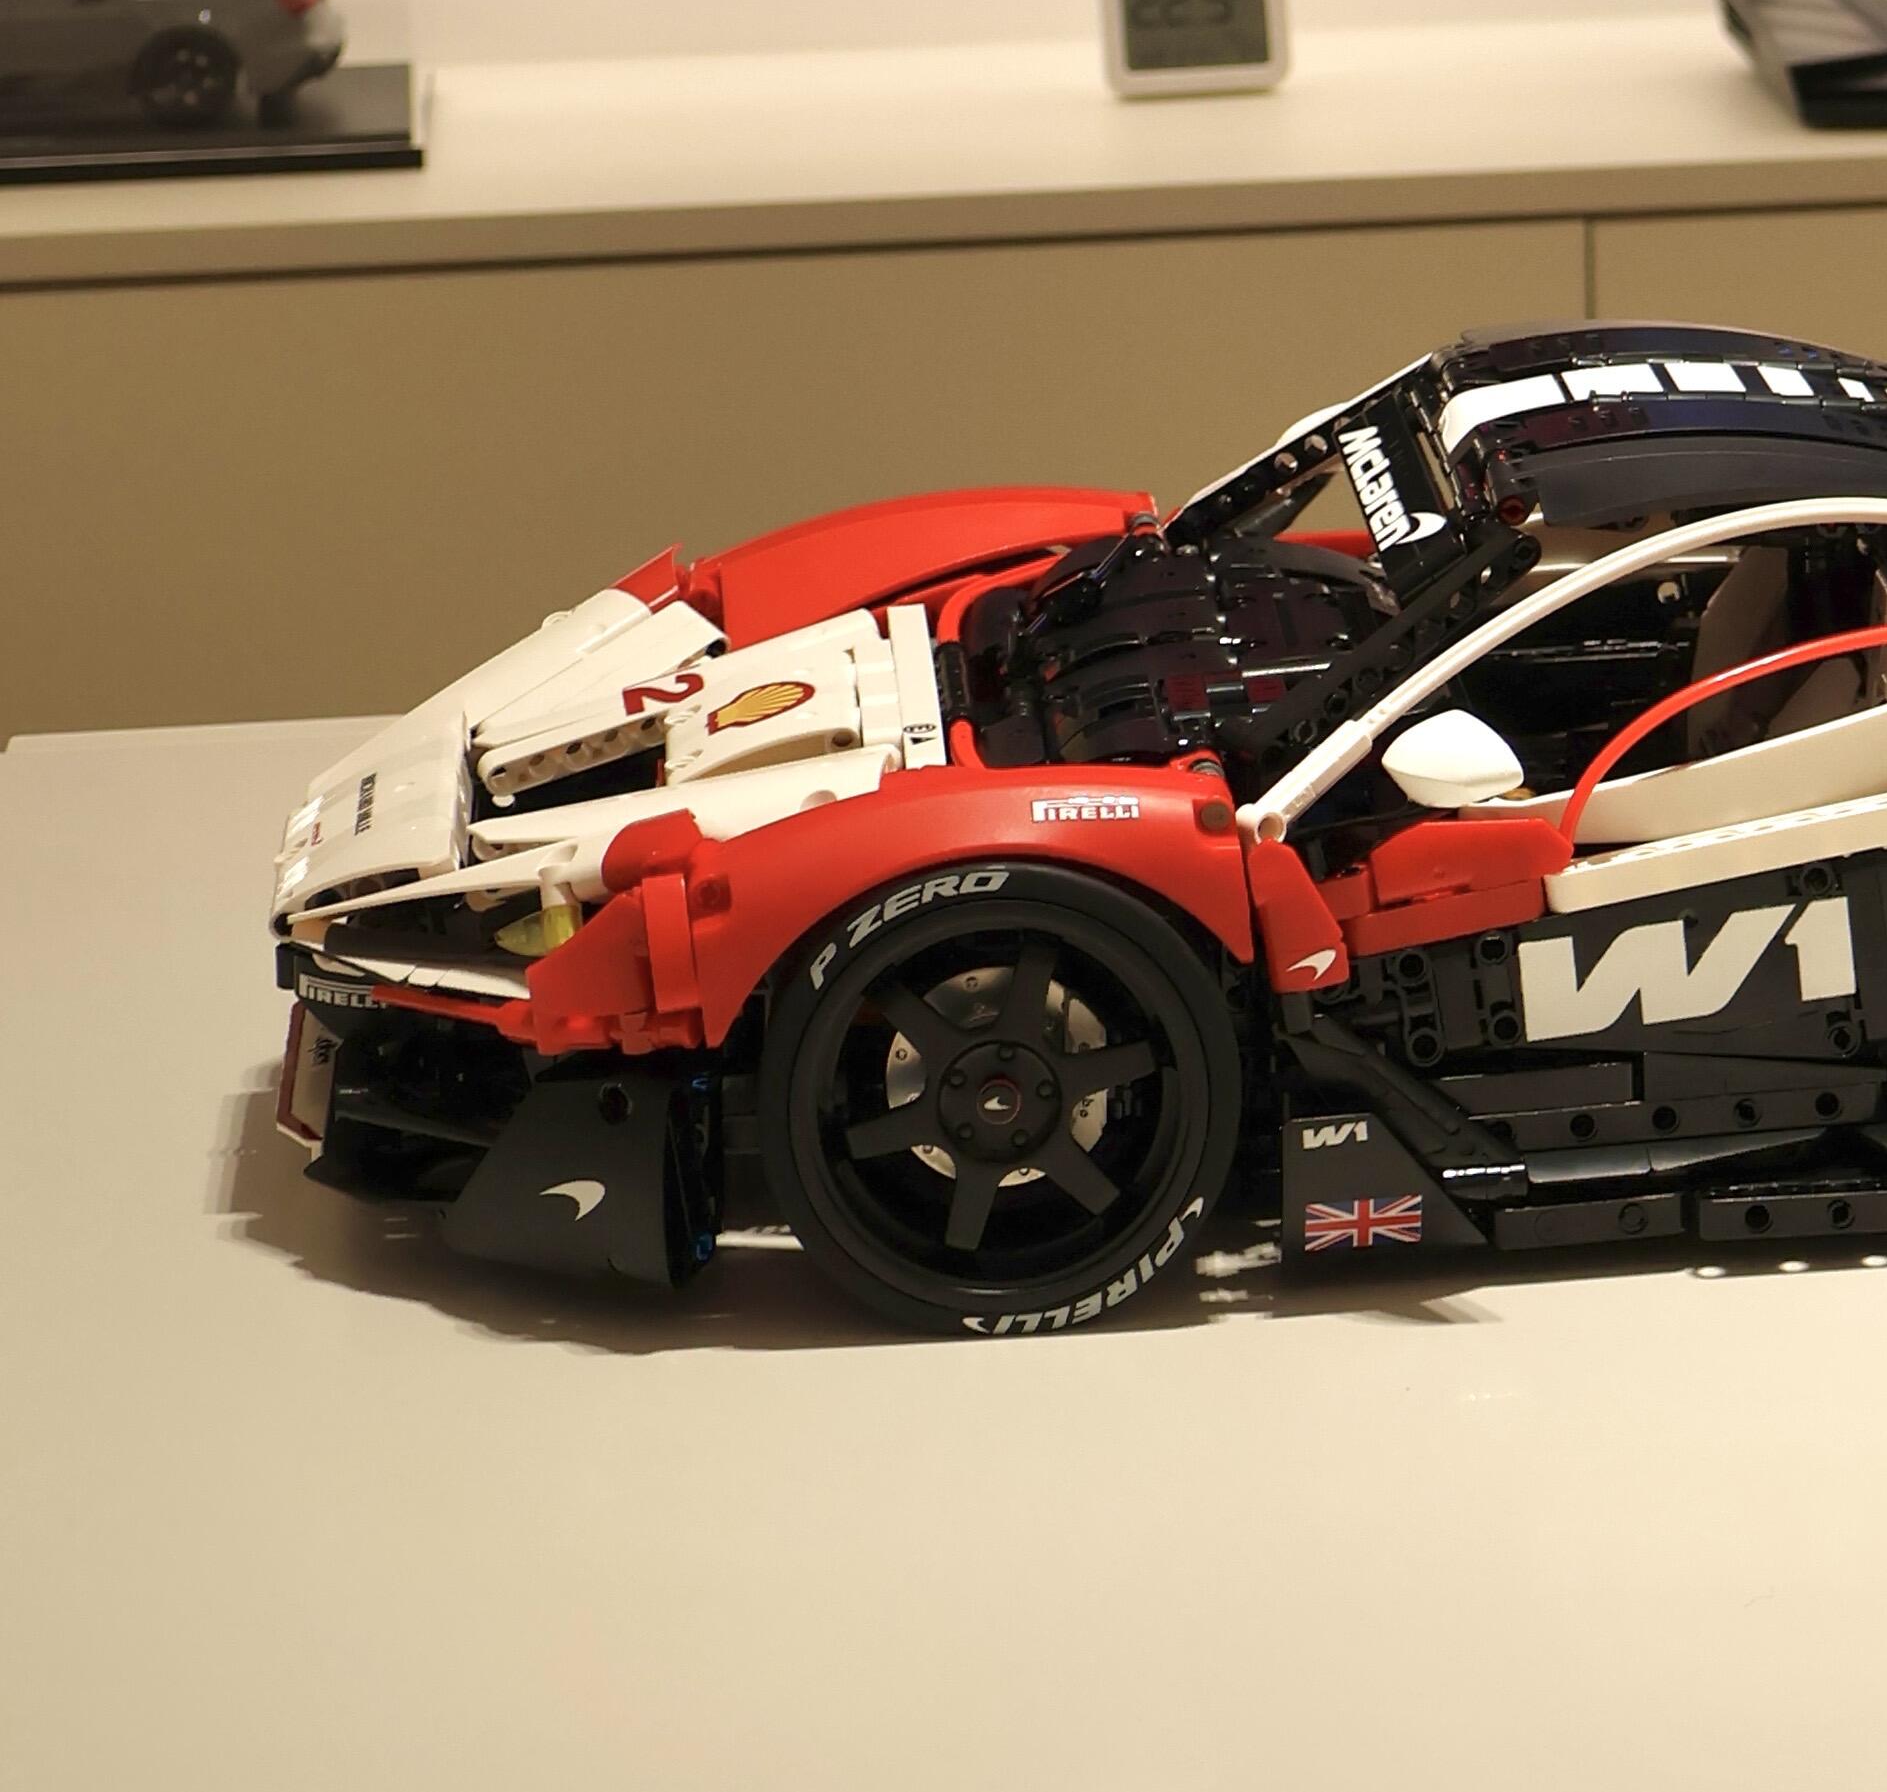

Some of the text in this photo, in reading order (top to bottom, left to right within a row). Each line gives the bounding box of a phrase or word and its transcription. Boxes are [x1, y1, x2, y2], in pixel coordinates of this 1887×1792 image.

[1337, 425, 1408, 553] McLaren
[1031, 795, 1140, 823] PIRELLI
[808, 869, 1011, 991] P ZERO
[1518, 895, 1858, 1043] W1
[1302, 1120, 1369, 1151] W1
[998, 1219, 1187, 1334] PIRELLI
